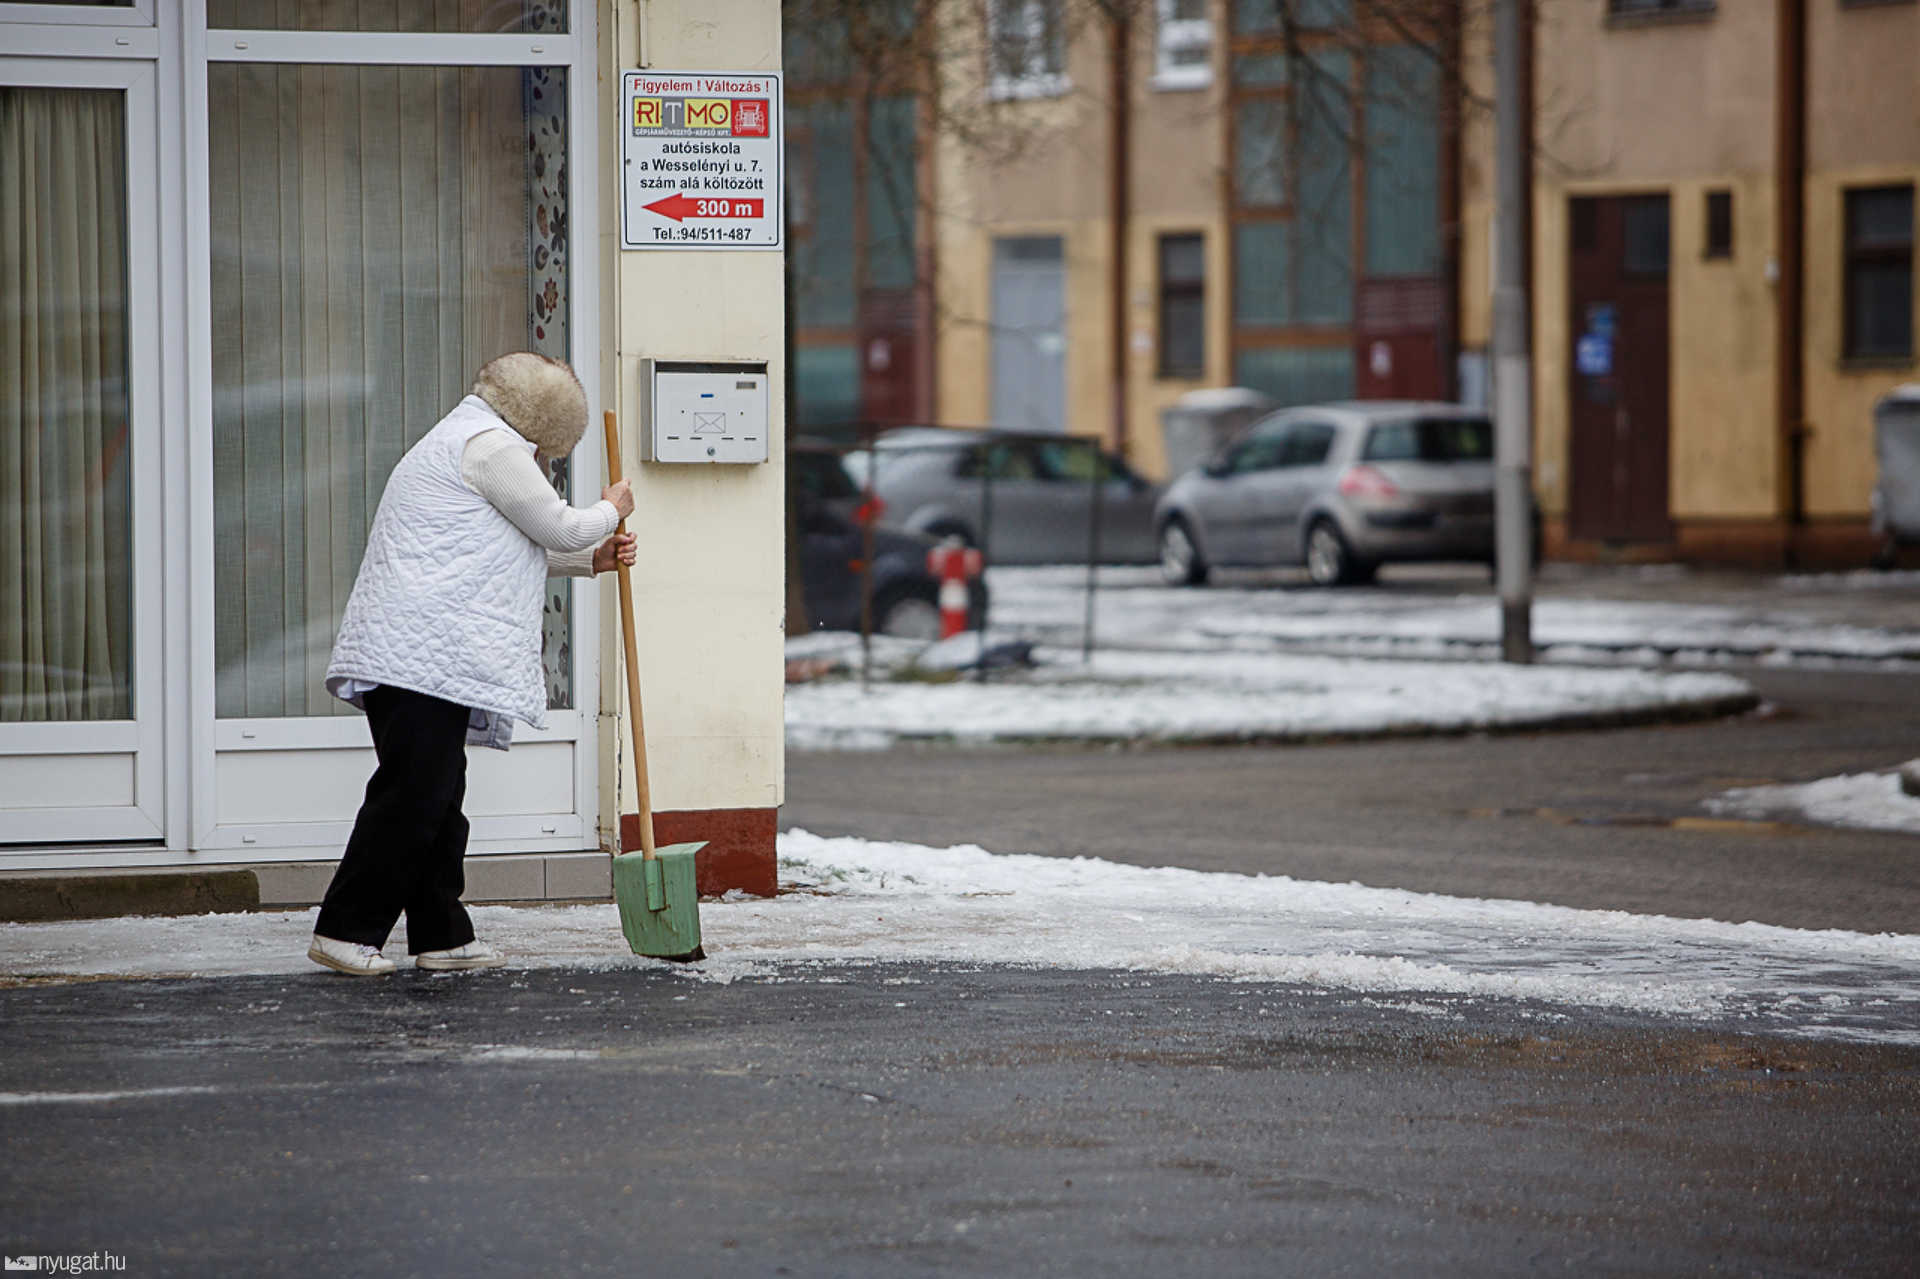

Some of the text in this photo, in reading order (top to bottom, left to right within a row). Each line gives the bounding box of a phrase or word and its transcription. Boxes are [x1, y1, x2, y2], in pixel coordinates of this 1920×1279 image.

[634, 79, 692, 93] Figyelem
[705, 80, 761, 92] Változás
[636, 101, 729, 125] RITMO
[662, 142, 741, 154] autósiskola
[640, 159, 763, 174] a Wesselényi u. 7.
[640, 177, 764, 190] szám alá költözött
[697, 200, 752, 216] 300 m
[652, 227, 752, 241] Tel.:94/511-487
